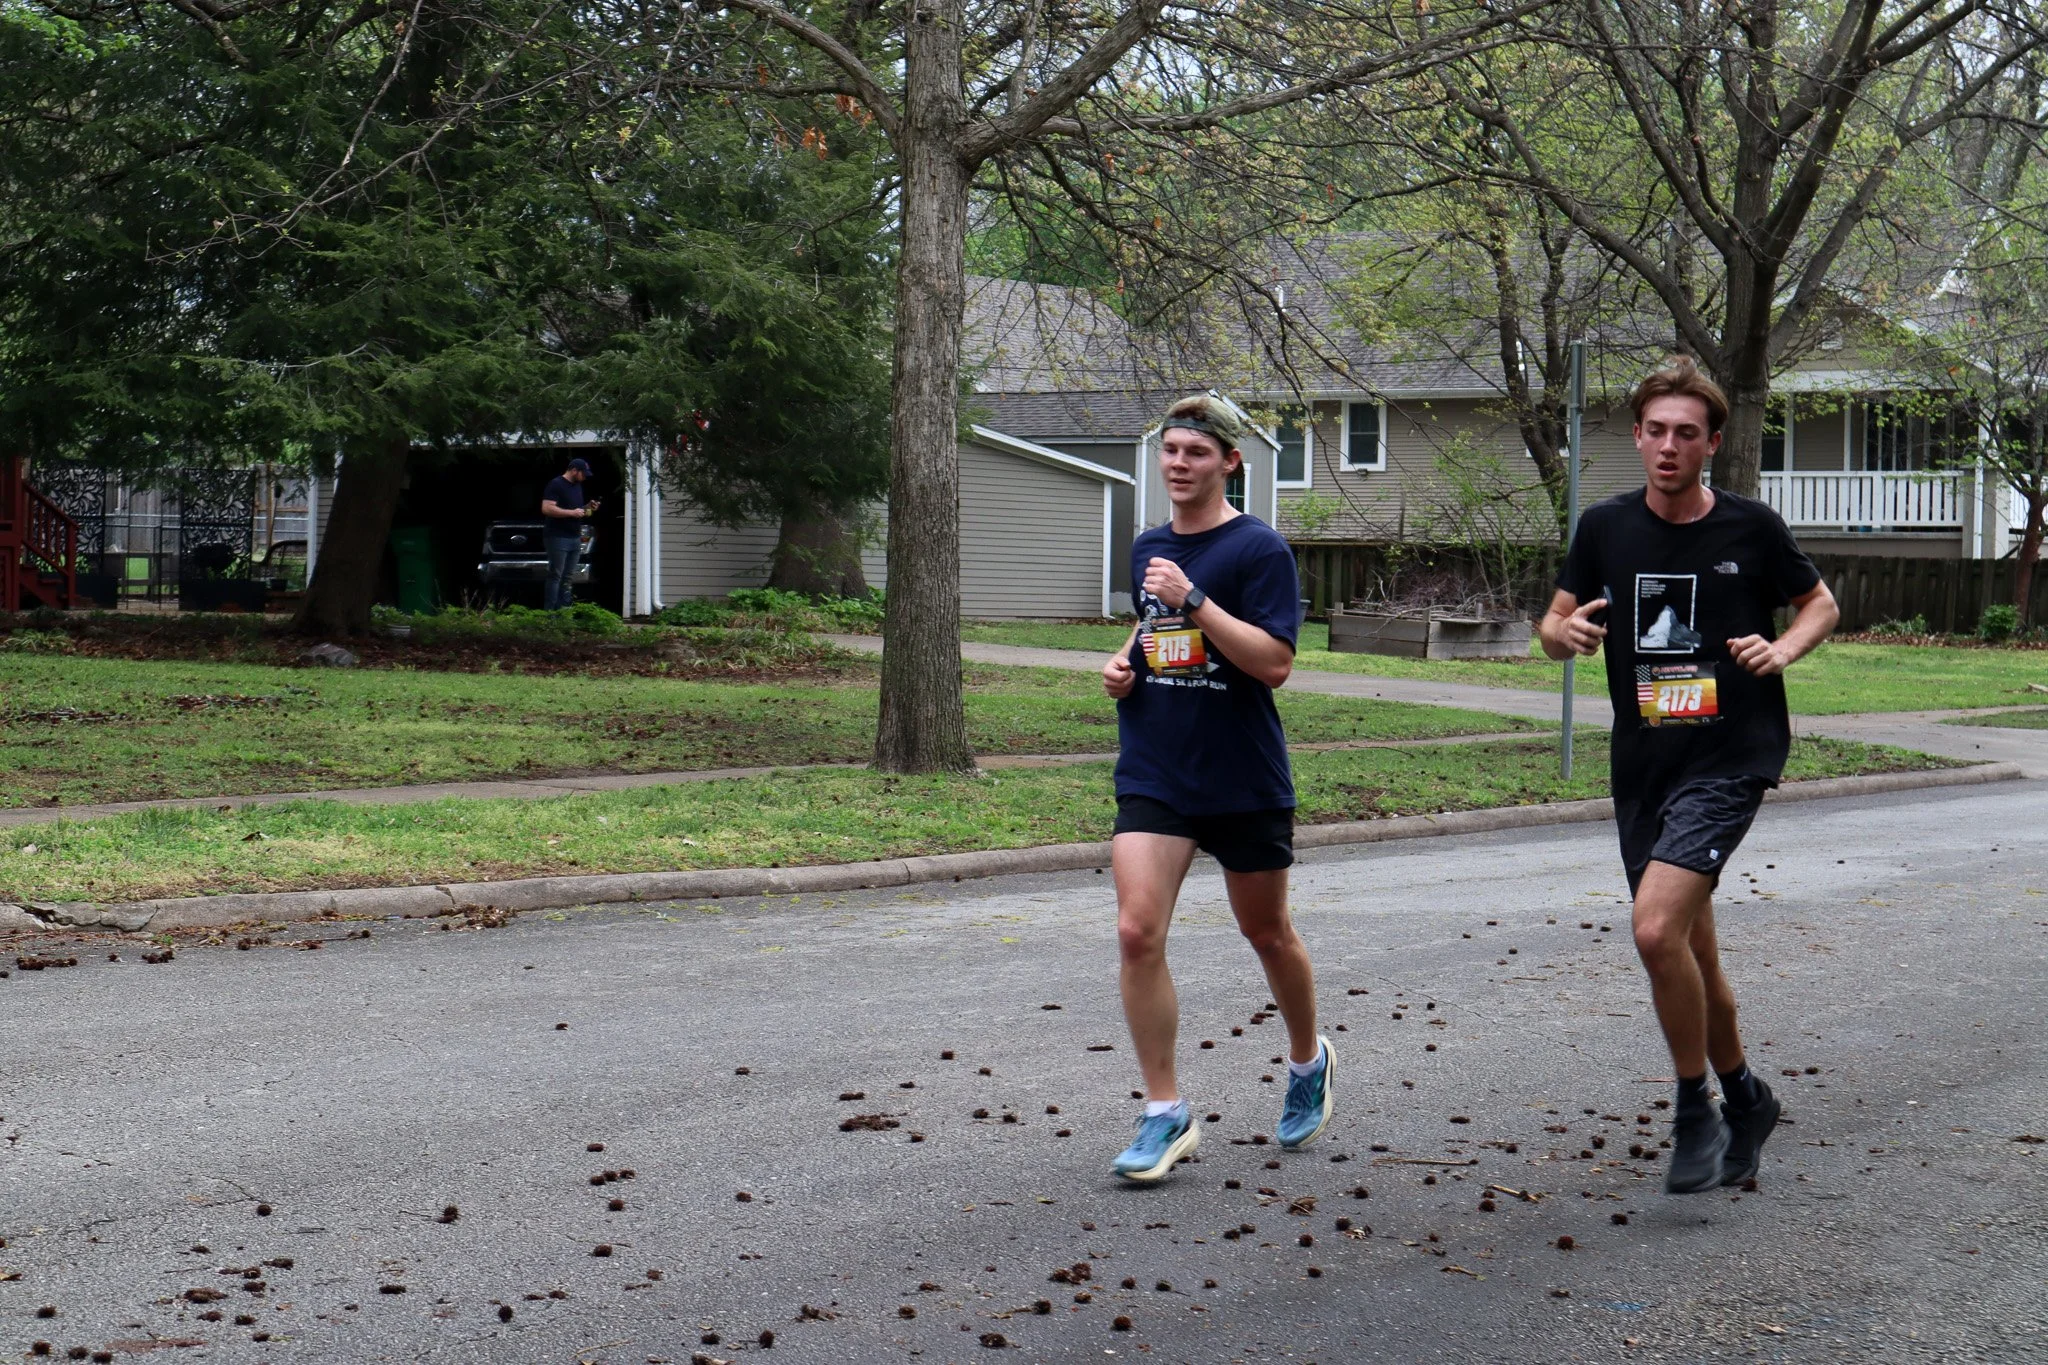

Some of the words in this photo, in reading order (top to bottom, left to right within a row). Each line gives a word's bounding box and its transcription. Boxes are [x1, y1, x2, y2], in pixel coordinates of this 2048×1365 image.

[1158, 635, 1191, 662] 2175
[1175, 678, 1186, 686] 5K
[1209, 680, 1227, 690] RUN
[1657, 684, 1703, 712] 2173
